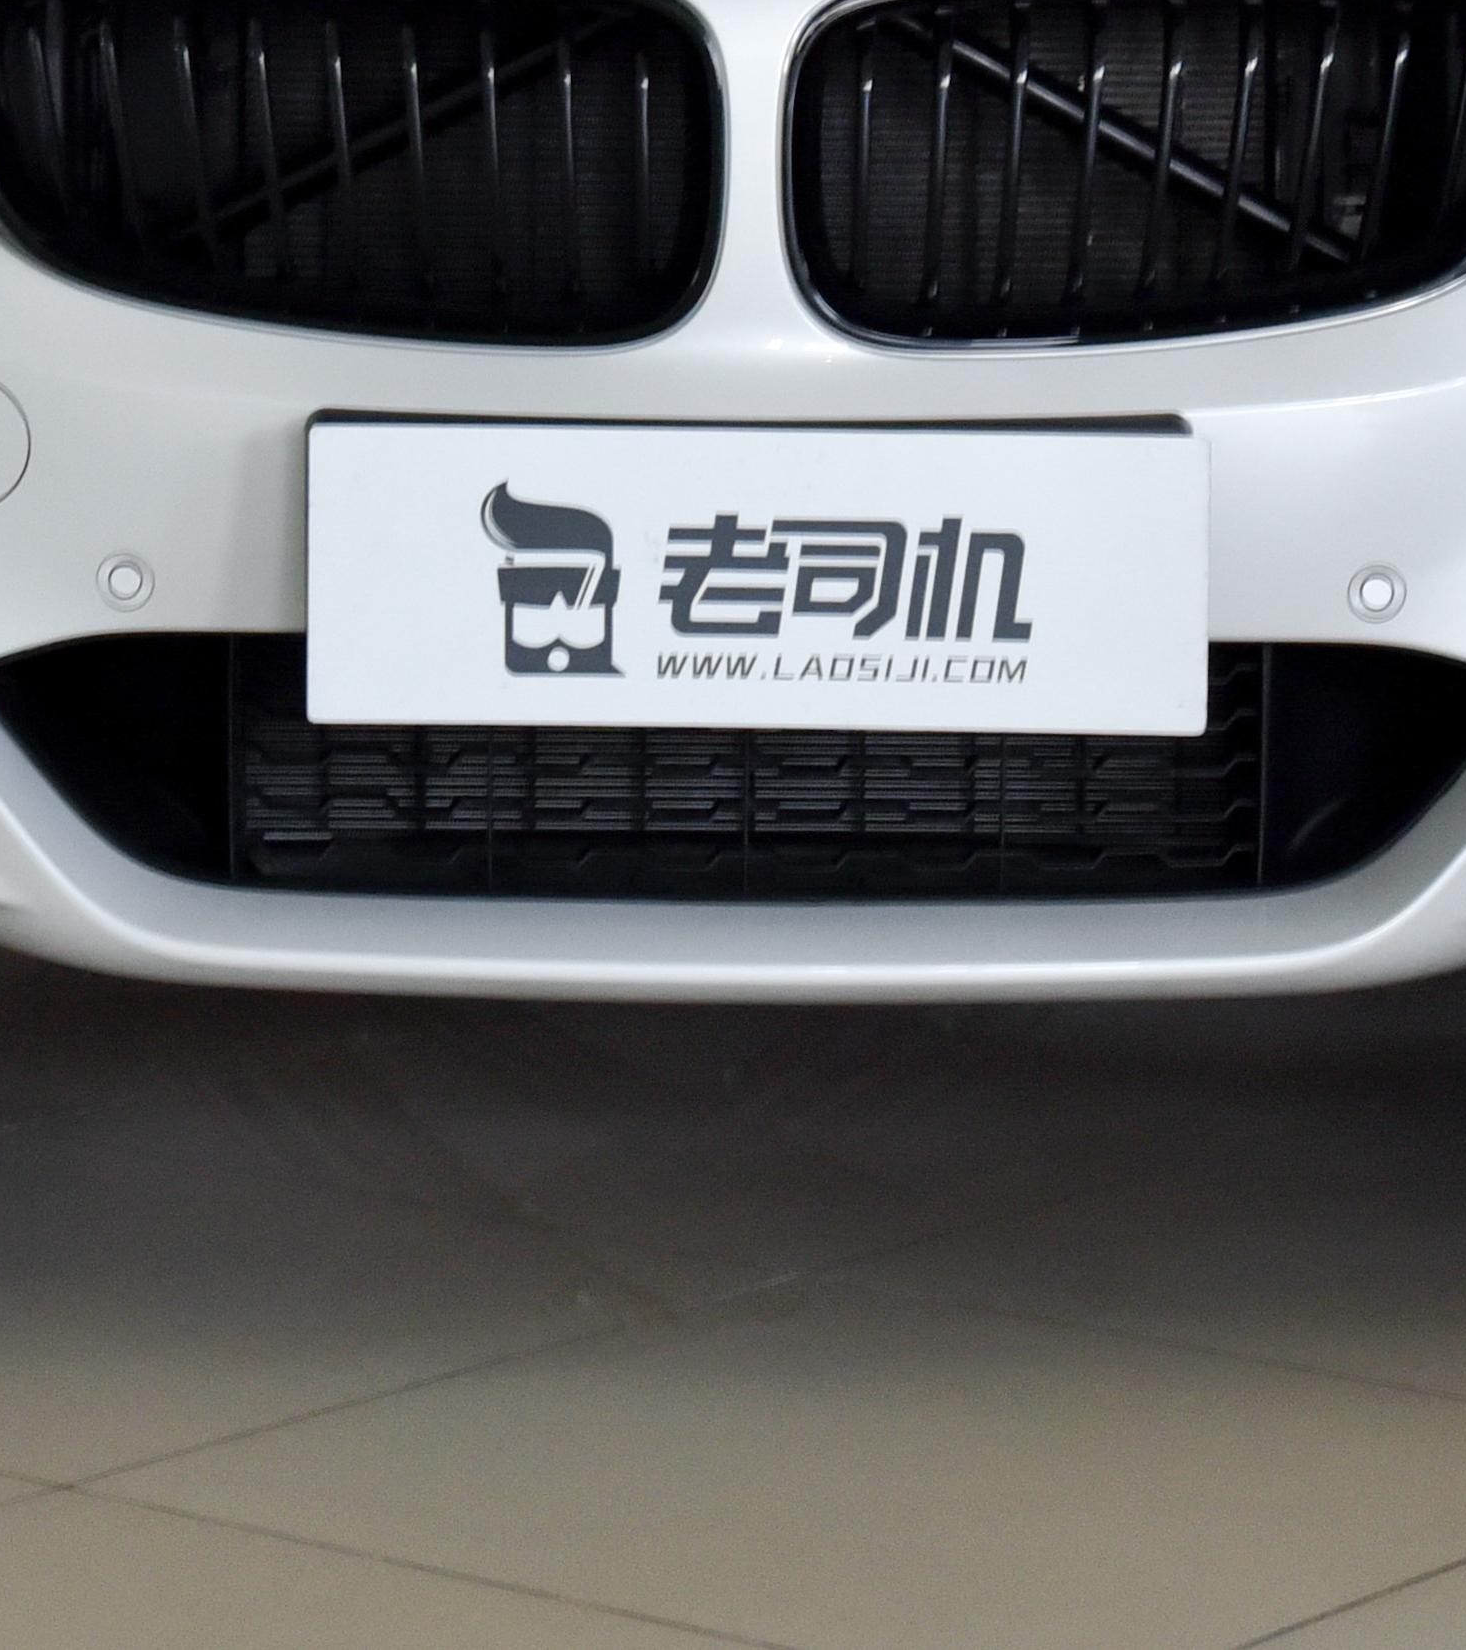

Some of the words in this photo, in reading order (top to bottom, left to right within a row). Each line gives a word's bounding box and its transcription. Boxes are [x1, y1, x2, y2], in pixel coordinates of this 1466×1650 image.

[658, 513, 1033, 641] 老司机
[656, 653, 1028, 684] WWW.LAOSIJI.COM
